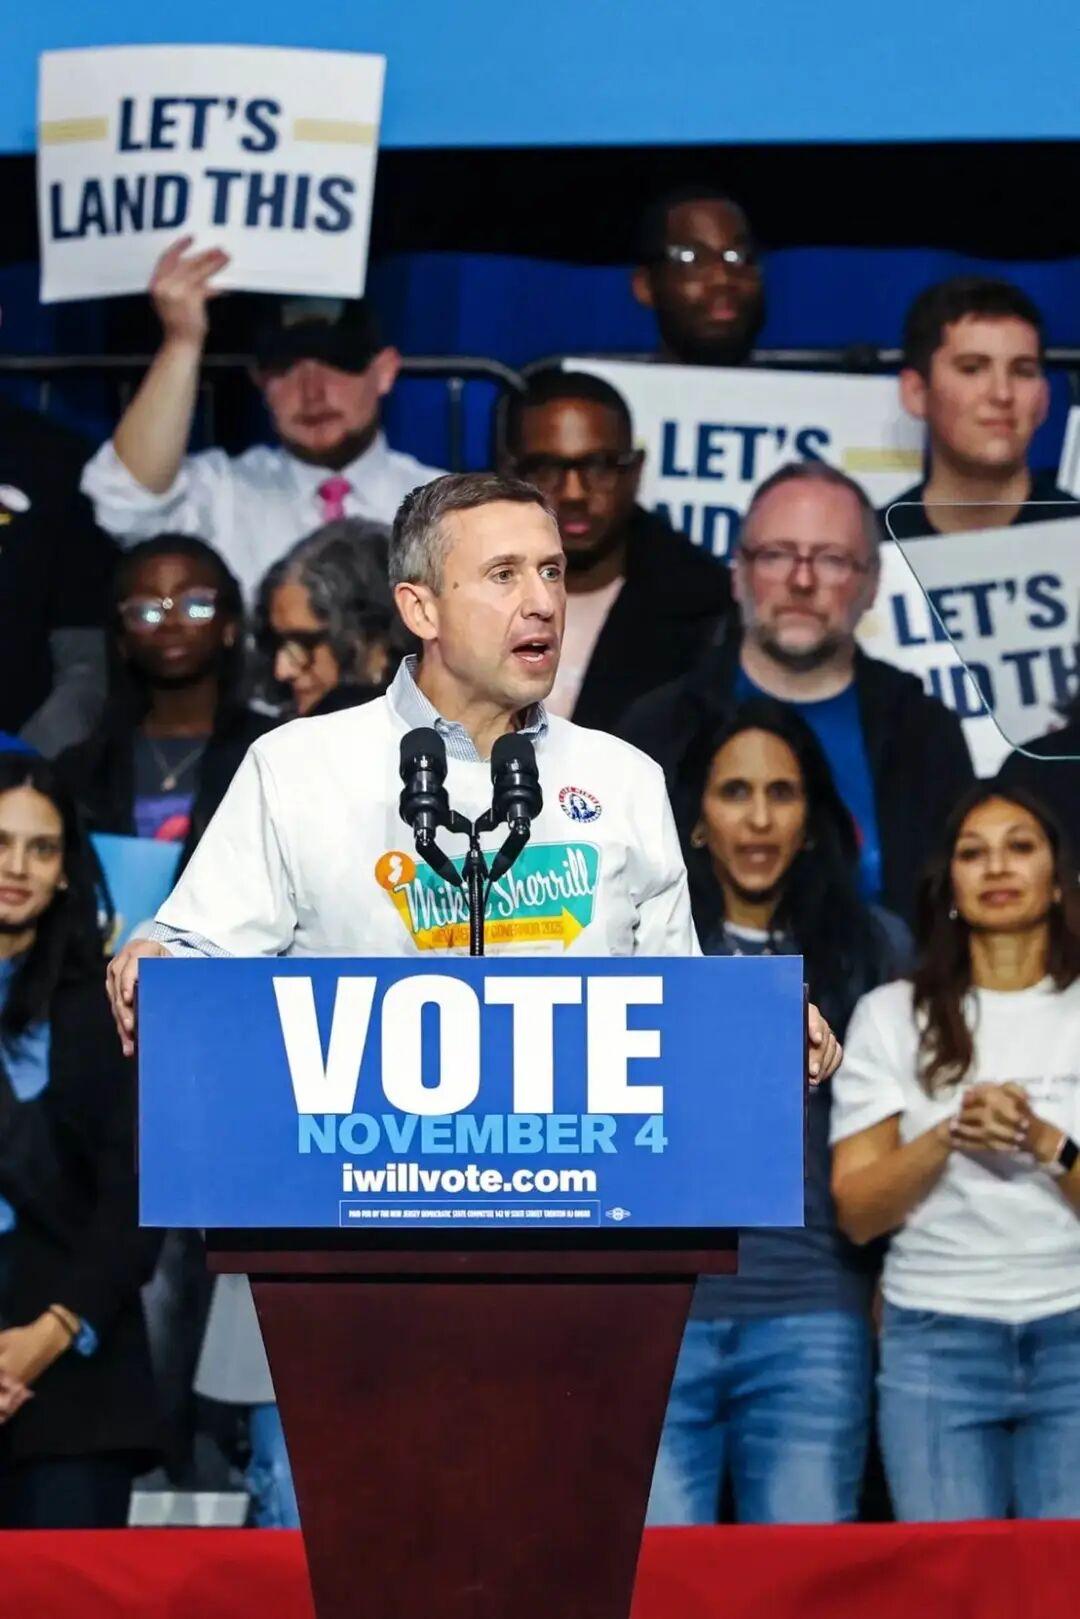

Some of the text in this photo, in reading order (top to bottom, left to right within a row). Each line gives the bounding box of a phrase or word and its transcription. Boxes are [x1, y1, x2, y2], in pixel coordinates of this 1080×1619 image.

[117, 96, 282, 154] LET'S
[49, 168, 357, 241] LAND THIS
[661, 421, 831, 481] LET'S
[890, 573, 1068, 646] LET'S
[492, 846, 596, 917] Sherrill
[272, 974, 664, 1116] VOTE
[298, 1113, 668, 1155] NOVEMBER 4
[342, 1162, 597, 1193] iwillvote.com
